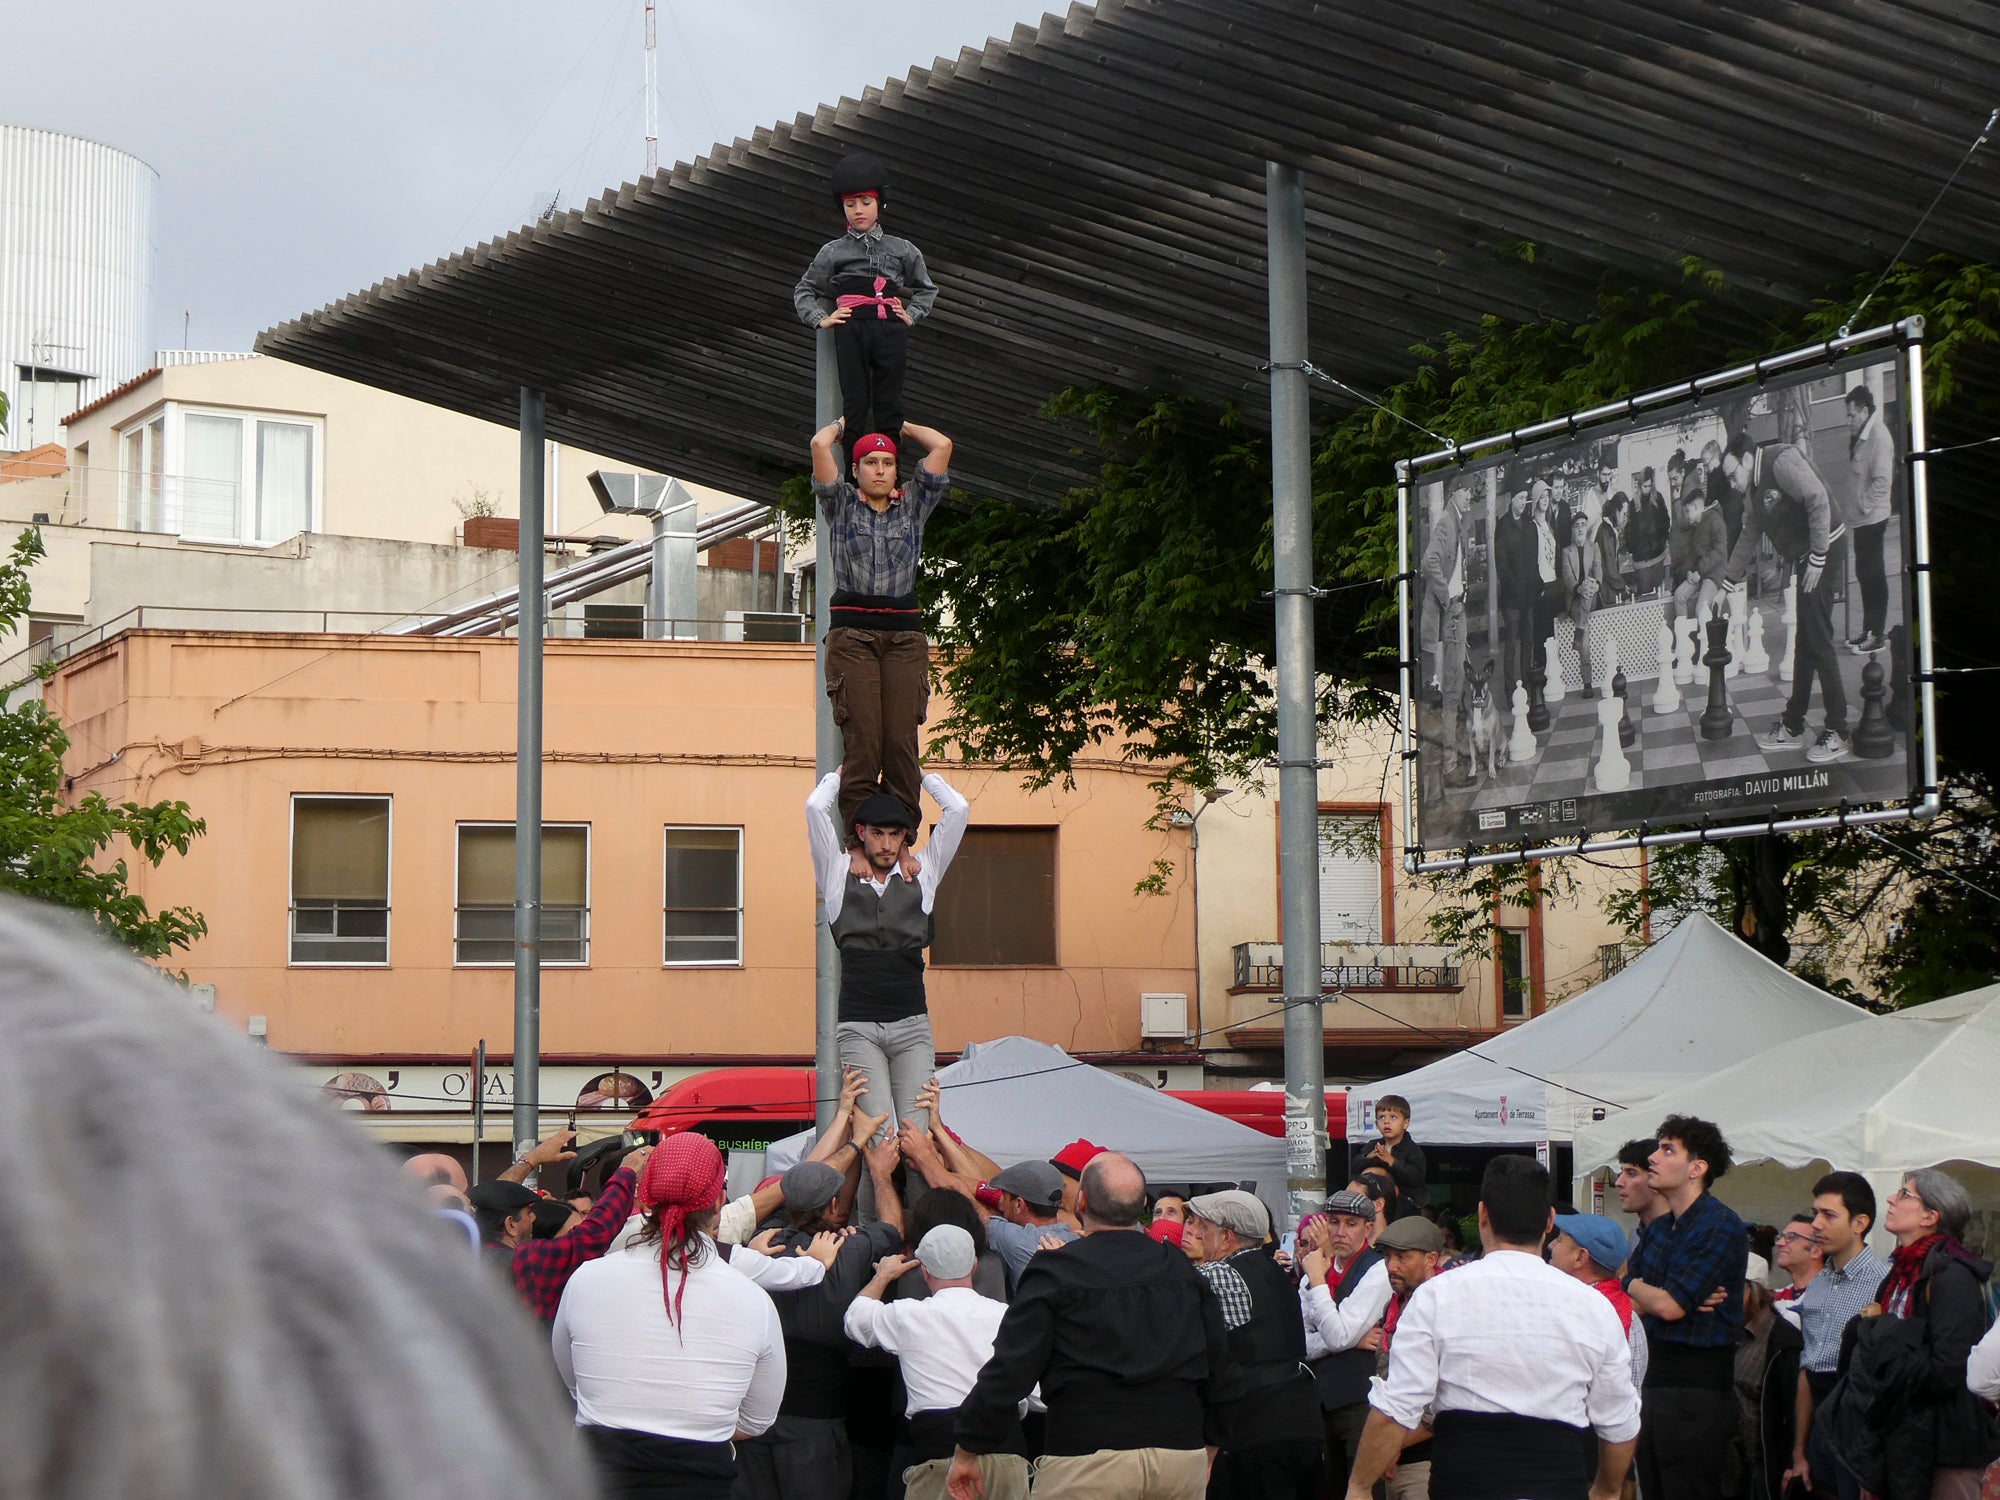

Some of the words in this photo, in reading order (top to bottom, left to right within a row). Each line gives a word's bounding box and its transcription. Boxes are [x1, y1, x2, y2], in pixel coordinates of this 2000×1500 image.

[1694, 787, 1742, 801] FOTOGRAFIA:
[1745, 778, 1780, 795] DAVID
[1783, 769, 1829, 791] MILLÁN
[1475, 1110, 1499, 1120] Ajuntament
[1509, 1110, 1516, 1118] de
[1516, 1109, 1535, 1119] Terrassa
[718, 1138, 773, 1150] BUSHÍBR
